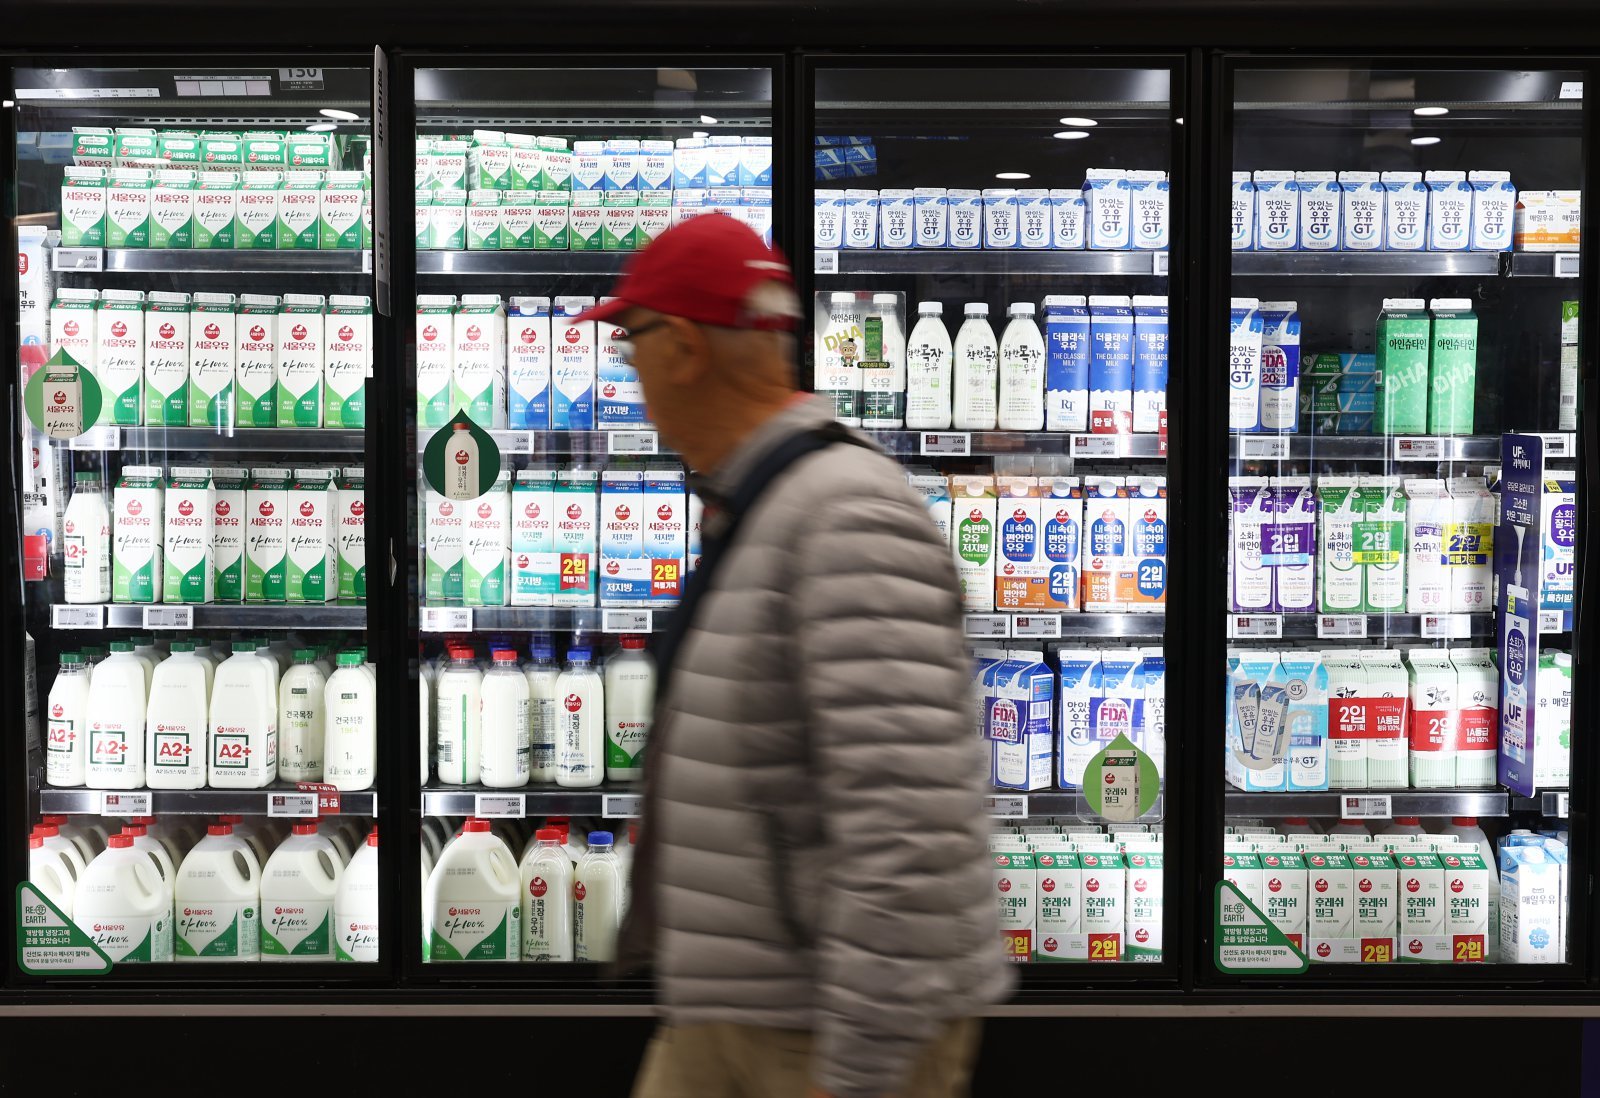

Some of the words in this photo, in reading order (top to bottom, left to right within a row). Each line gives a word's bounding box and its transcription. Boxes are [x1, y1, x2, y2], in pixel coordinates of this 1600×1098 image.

[65, 191, 102, 201] 서울우유
[155, 193, 190, 204] 서울우유
[240, 194, 274, 204] 서울우유
[1099, 199, 1124, 209] 맛있는
[1139, 200, 1164, 210] 맛있는
[1265, 200, 1292, 211] 맛있는
[1351, 200, 1377, 211] 맛있는
[1482, 200, 1508, 211] 맛있는
[504, 208, 532, 216] 서울우유
[537, 208, 565, 216] 서울우유
[606, 209, 634, 217] 서울우유
[1102, 209, 1121, 221] 우유
[1142, 210, 1162, 221] 우유
[1268, 212, 1289, 222] 우유
[1354, 212, 1374, 222] 우유
[1484, 212, 1504, 222] 우유
[922, 227, 938, 236] GT
[1102, 221, 1121, 233] GT
[1142, 222, 1161, 234] GT
[1269, 223, 1287, 235] GT
[1354, 223, 1373, 235] GT
[1484, 223, 1503, 235] GT
[831, 314, 860, 323] 아인슈타인
[824, 325, 863, 351] DHA
[1053, 333, 1086, 341] 더클래식
[150, 340, 184, 350] 서울우유
[195, 340, 229, 350] 서울우유
[283, 341, 316, 351] 서울우유
[1061, 341, 1077, 350] 우유
[1389, 338, 1427, 350] 아인슈타인
[1438, 338, 1475, 350] 아인슈타인
[512, 345, 545, 354] 서울우유
[556, 345, 589, 354] 서울우유
[1231, 358, 1253, 370] 우유
[1231, 371, 1252, 382] GT
[1388, 362, 1427, 393] DHA
[47, 405, 74, 413] 서울우유
[603, 406, 629, 415] 저지방
[169, 518, 202, 527] 서울우유
[250, 518, 282, 527] 서울우유
[291, 517, 323, 526] 서울우유
[558, 521, 590, 530] 서울우유
[606, 522, 638, 530] 서울우유
[962, 524, 989, 534] 속편한
[962, 534, 979, 542] 우유
[1006, 534, 1033, 543] 편안한
[1048, 534, 1075, 543] 편안한
[1240, 531, 1254, 540] 소화
[1330, 532, 1344, 540] 소화
[1271, 534, 1299, 552] 2입
[1362, 532, 1390, 550] 2입
[962, 543, 988, 552] 저지방
[1006, 543, 1024, 552] 우유
[1048, 544, 1066, 553] 우유
[563, 558, 586, 575] 2입
[654, 564, 677, 581] 2입
[1141, 566, 1162, 581] 2입
[606, 583, 632, 593] 저지방
[1101, 708, 1128, 721] FDA
[1339, 706, 1366, 723] 2입
[1392, 705, 1400, 714] hy
[1509, 703, 1522, 722] UF
[286, 710, 313, 720] 건국목장
[994, 708, 1016, 722] FDA
[1377, 716, 1399, 724] 1A등급
[993, 727, 1008, 737] 120
[1340, 724, 1366, 732] 특별기획
[160, 742, 192, 756] A2+
[220, 744, 251, 758] A2+
[1105, 788, 1127, 796] 후레쉬
[1042, 897, 1071, 907] 후레쉬
[1315, 898, 1344, 907] 후레쉬
[1451, 898, 1479, 907] 후레쉬
[1042, 908, 1061, 917] 밀크
[1315, 908, 1334, 917] 밀크
[1451, 909, 1469, 917] 밀크
[1092, 940, 1117, 957] 2입
[1456, 942, 1481, 959] 2입
[1365, 946, 1389, 962] 2입
